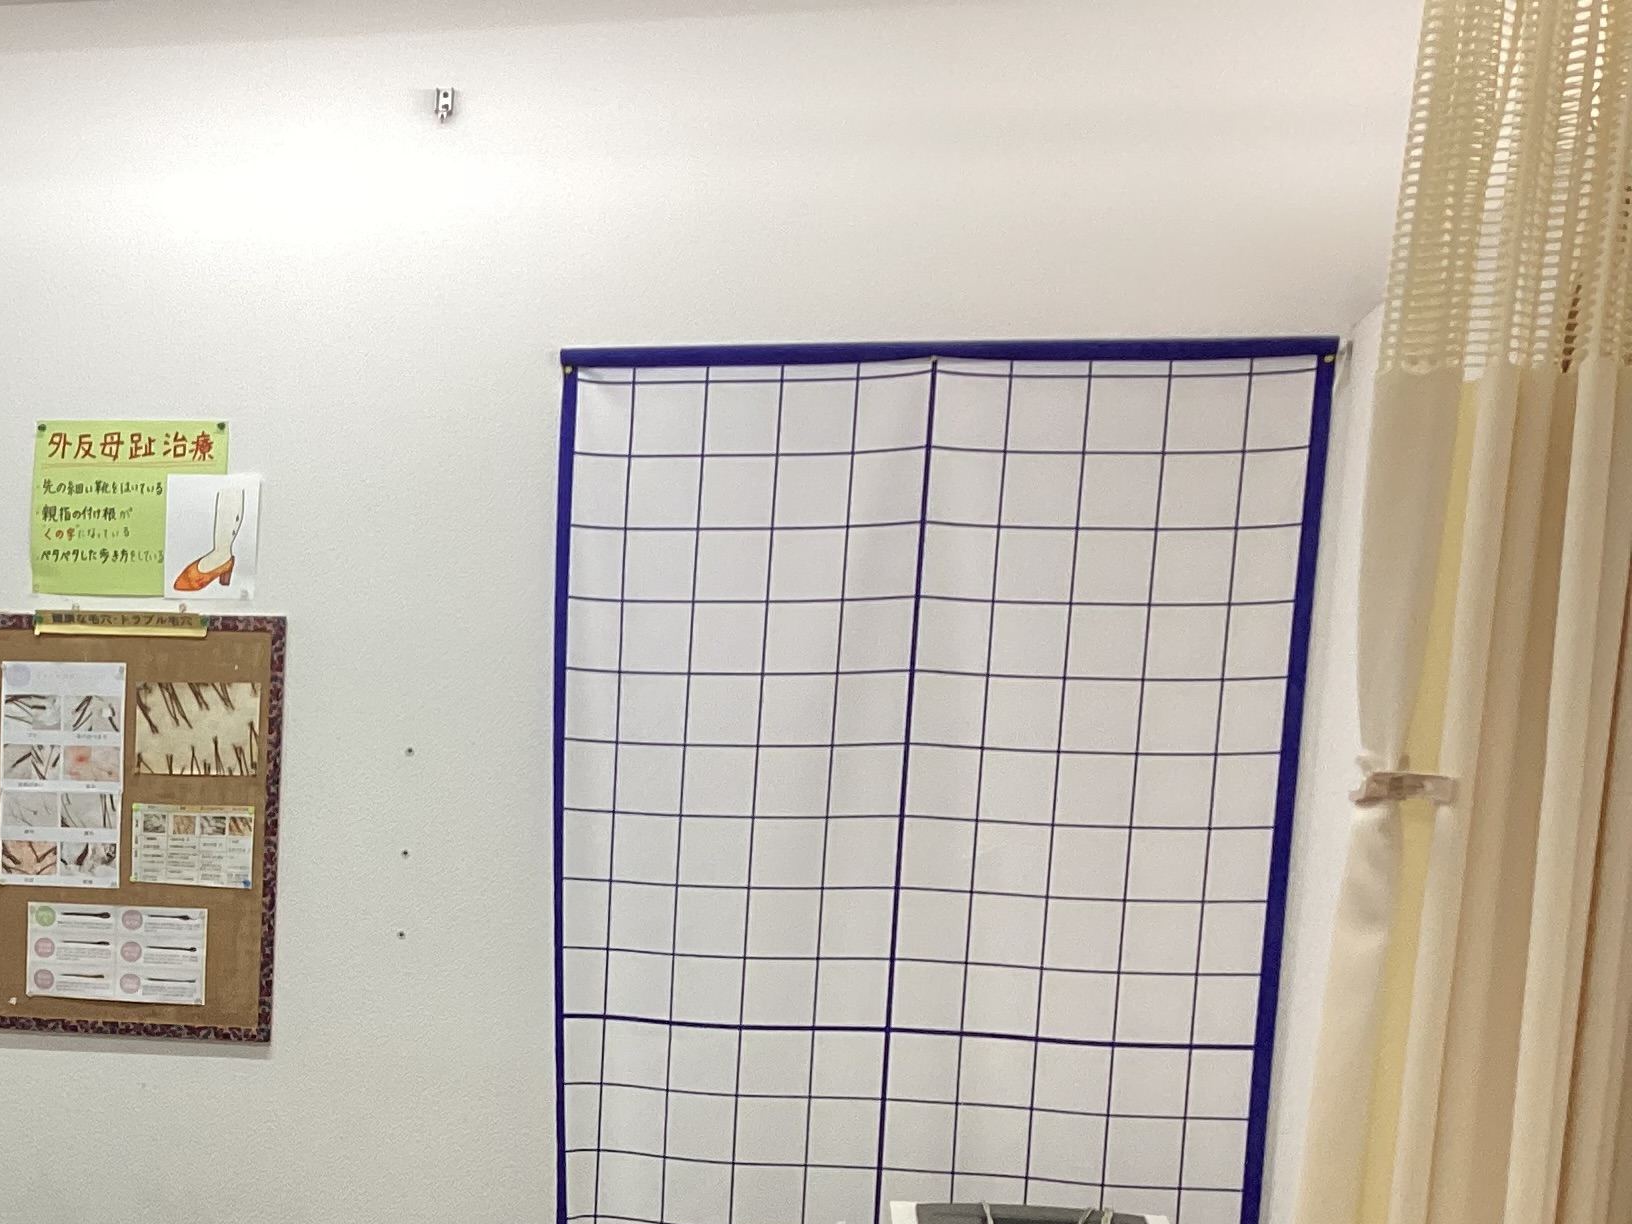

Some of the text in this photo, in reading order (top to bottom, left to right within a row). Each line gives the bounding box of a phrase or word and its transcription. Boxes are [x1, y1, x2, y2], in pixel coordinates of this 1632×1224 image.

[48, 431, 214, 461] 外反母趾治療
